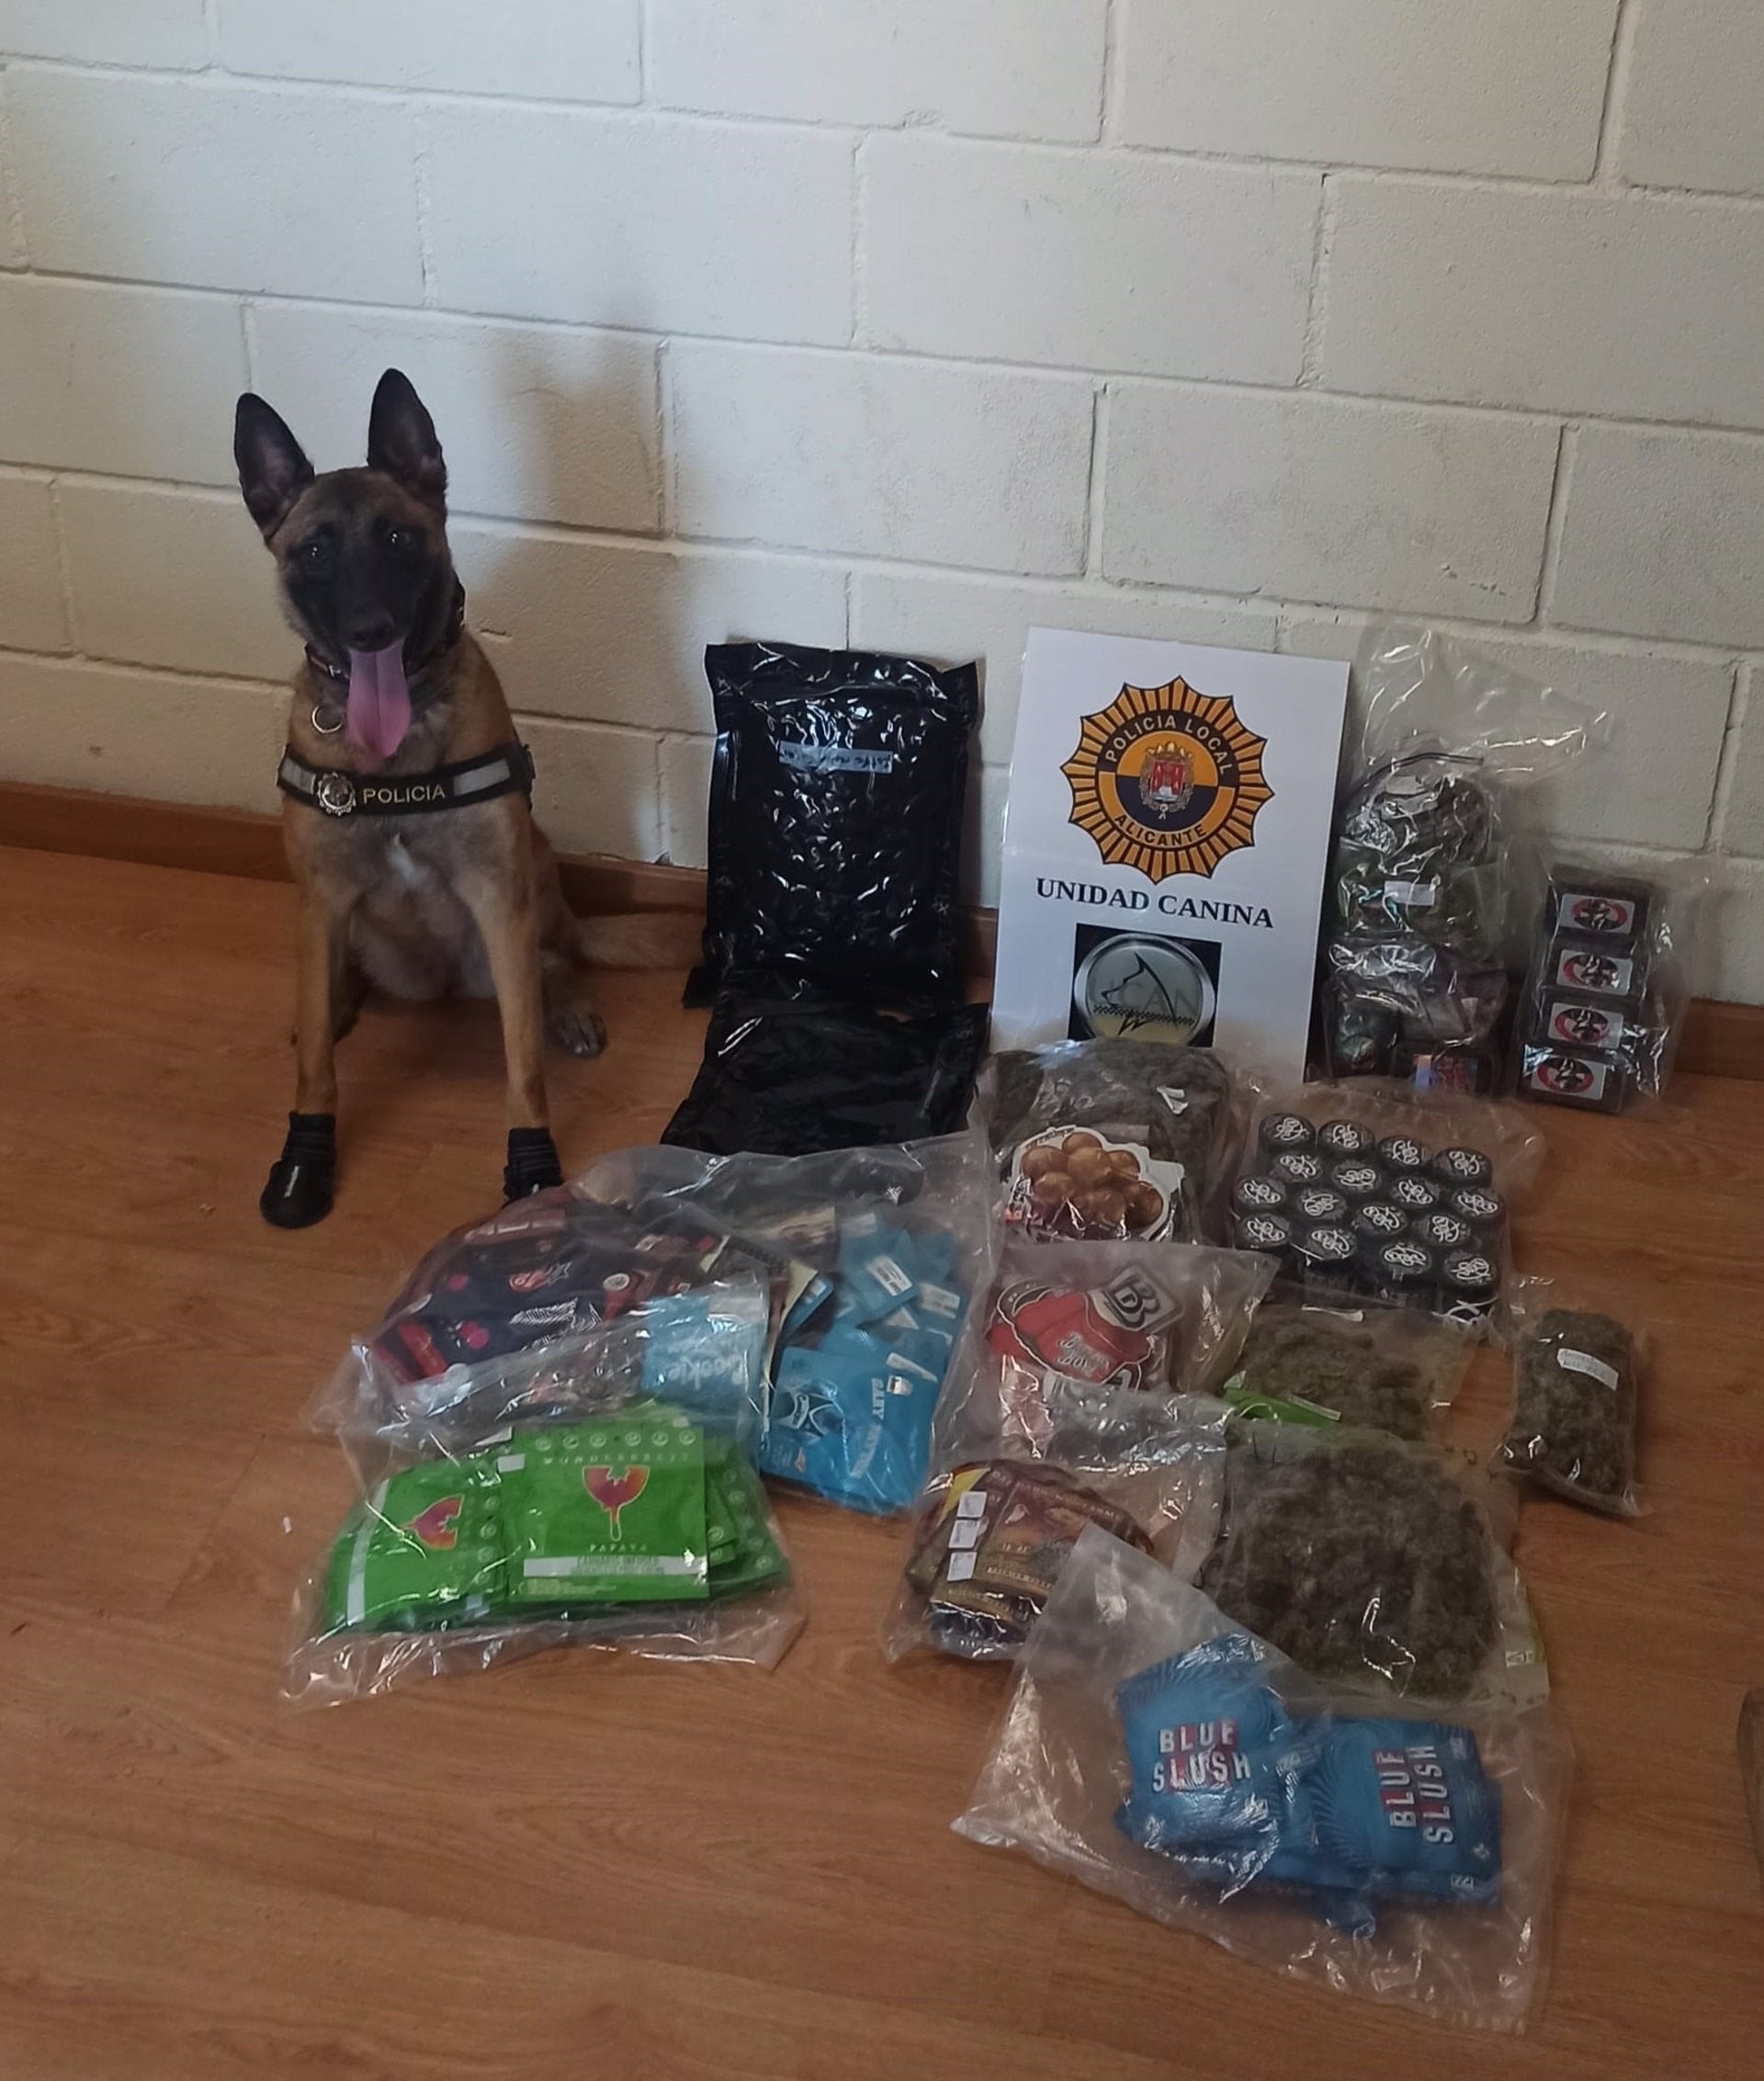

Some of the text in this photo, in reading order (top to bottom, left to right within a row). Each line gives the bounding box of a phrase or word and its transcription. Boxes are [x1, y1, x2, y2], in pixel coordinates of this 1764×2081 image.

[1105, 715, 1236, 775] POLICIA LOCAL
[363, 785, 446, 804] POLICIA
[1114, 814, 1206, 846] ALICANTE
[1036, 877, 1274, 928] UNIDAD CANINA
[1159, 1721, 1236, 1753] BLUE
[1152, 1750, 1252, 1793] SLUSH
[1378, 1749, 1416, 1828] BLUE
[1408, 1745, 1454, 1843] SLUSH
